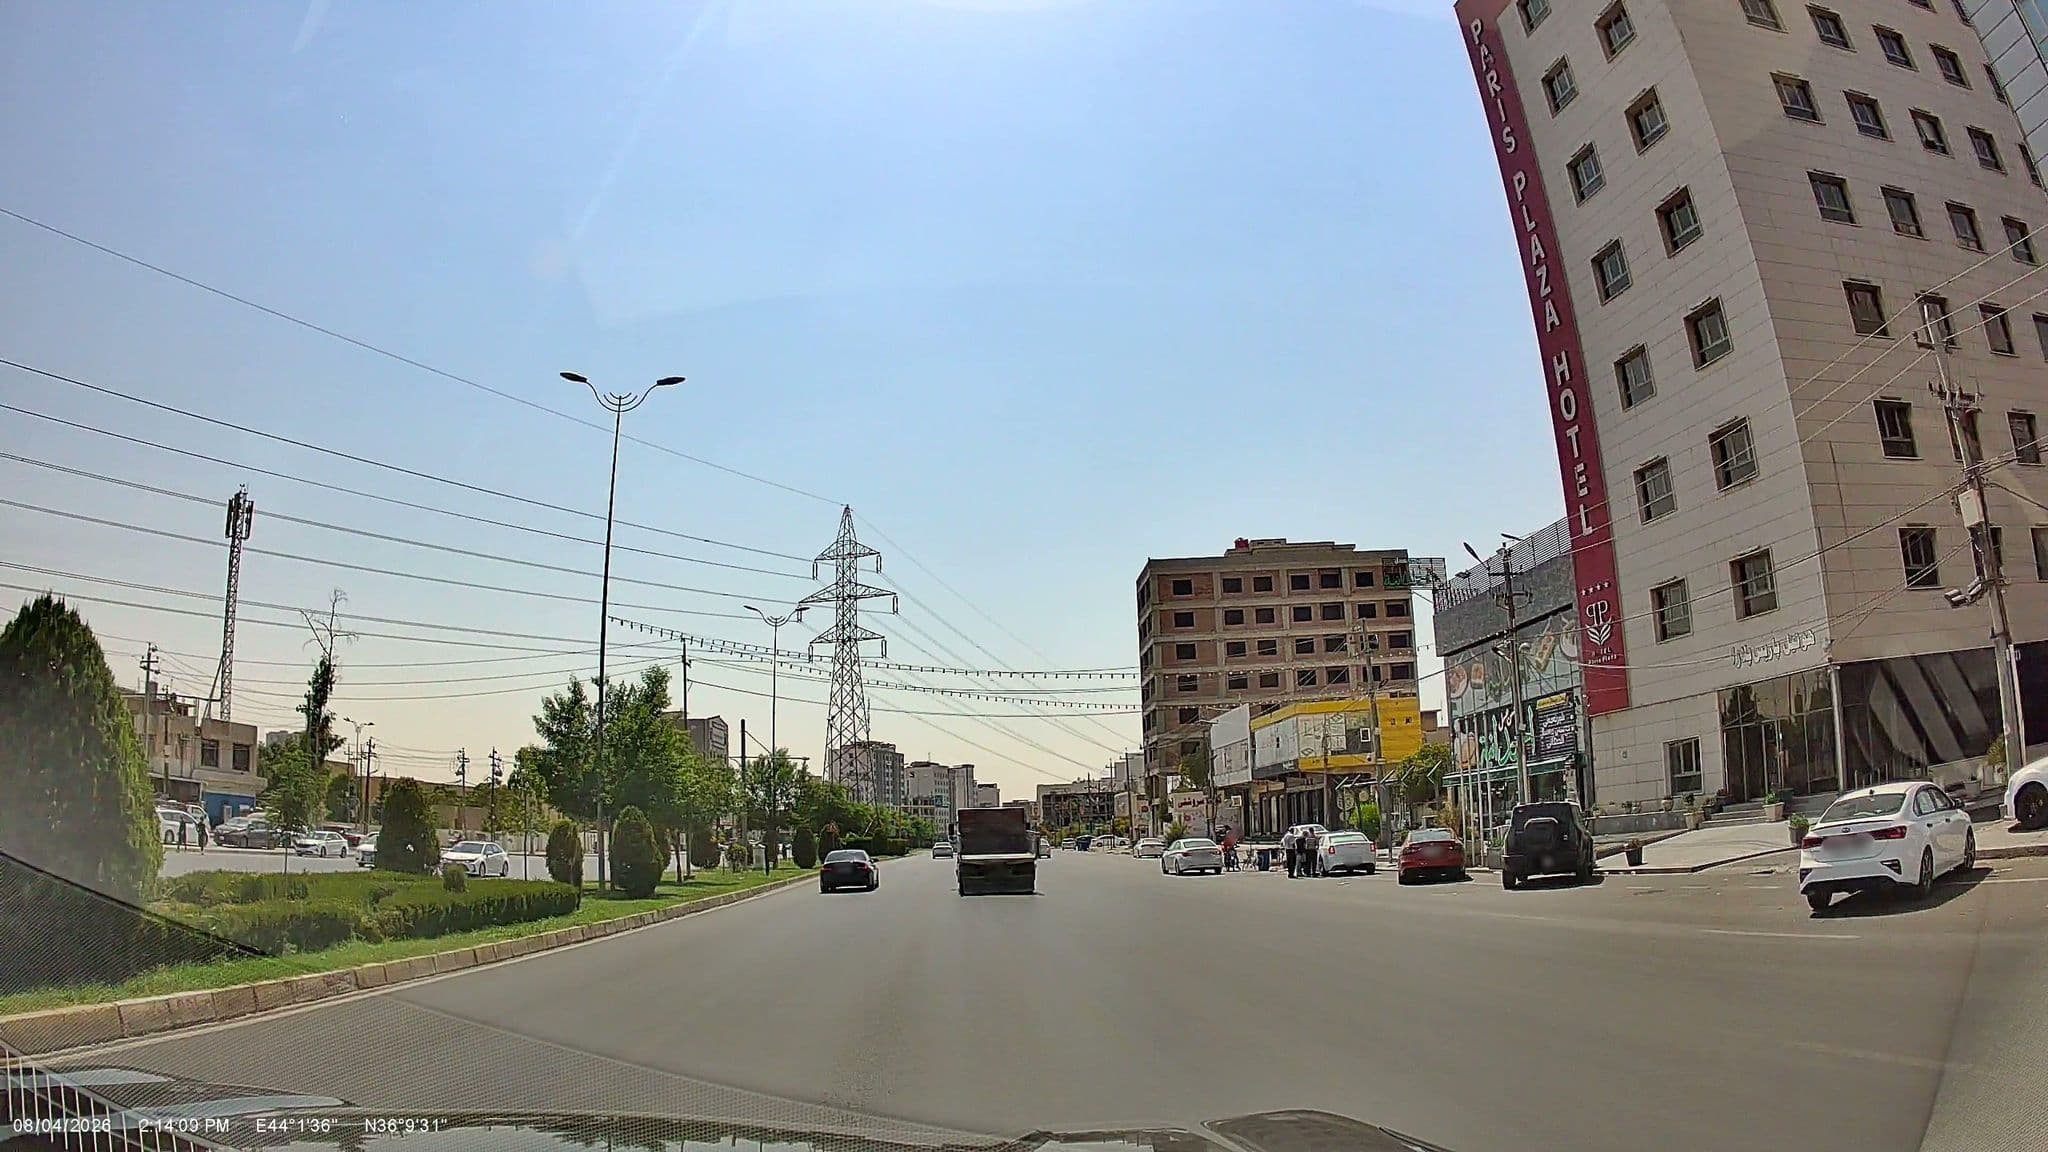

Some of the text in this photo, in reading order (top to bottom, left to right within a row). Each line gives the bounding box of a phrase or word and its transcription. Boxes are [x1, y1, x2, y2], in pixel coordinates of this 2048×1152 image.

[1470, 18, 1593, 537] PARIS PLAZA HOTEL
